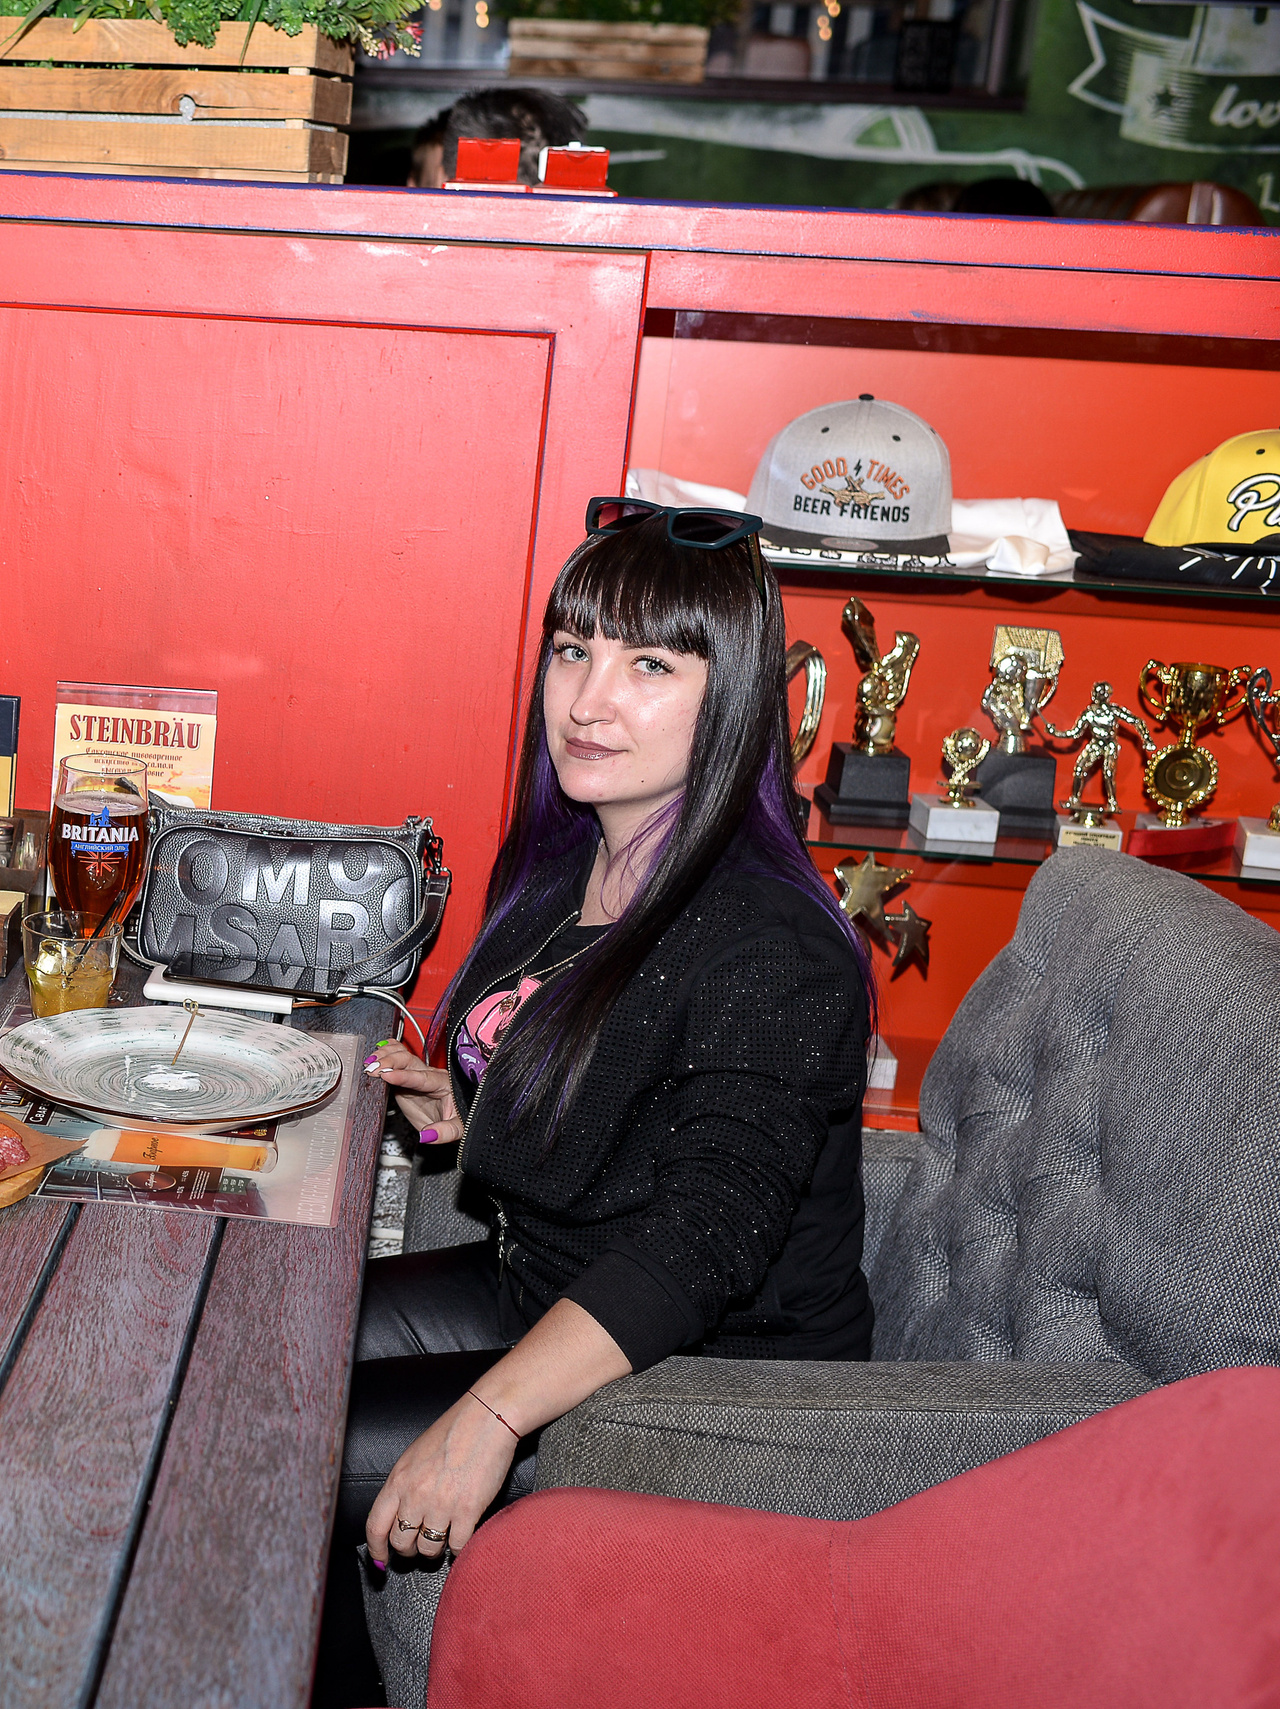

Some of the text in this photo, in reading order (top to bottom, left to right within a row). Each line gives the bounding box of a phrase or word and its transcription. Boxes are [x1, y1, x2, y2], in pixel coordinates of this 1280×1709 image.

[801, 457, 910, 500] GOOD TIMES
[793, 494, 910, 522] BEER FRIENDS
[70, 714, 202, 750] STEINBRÄU
[61, 823, 140, 843] BRITANIA
